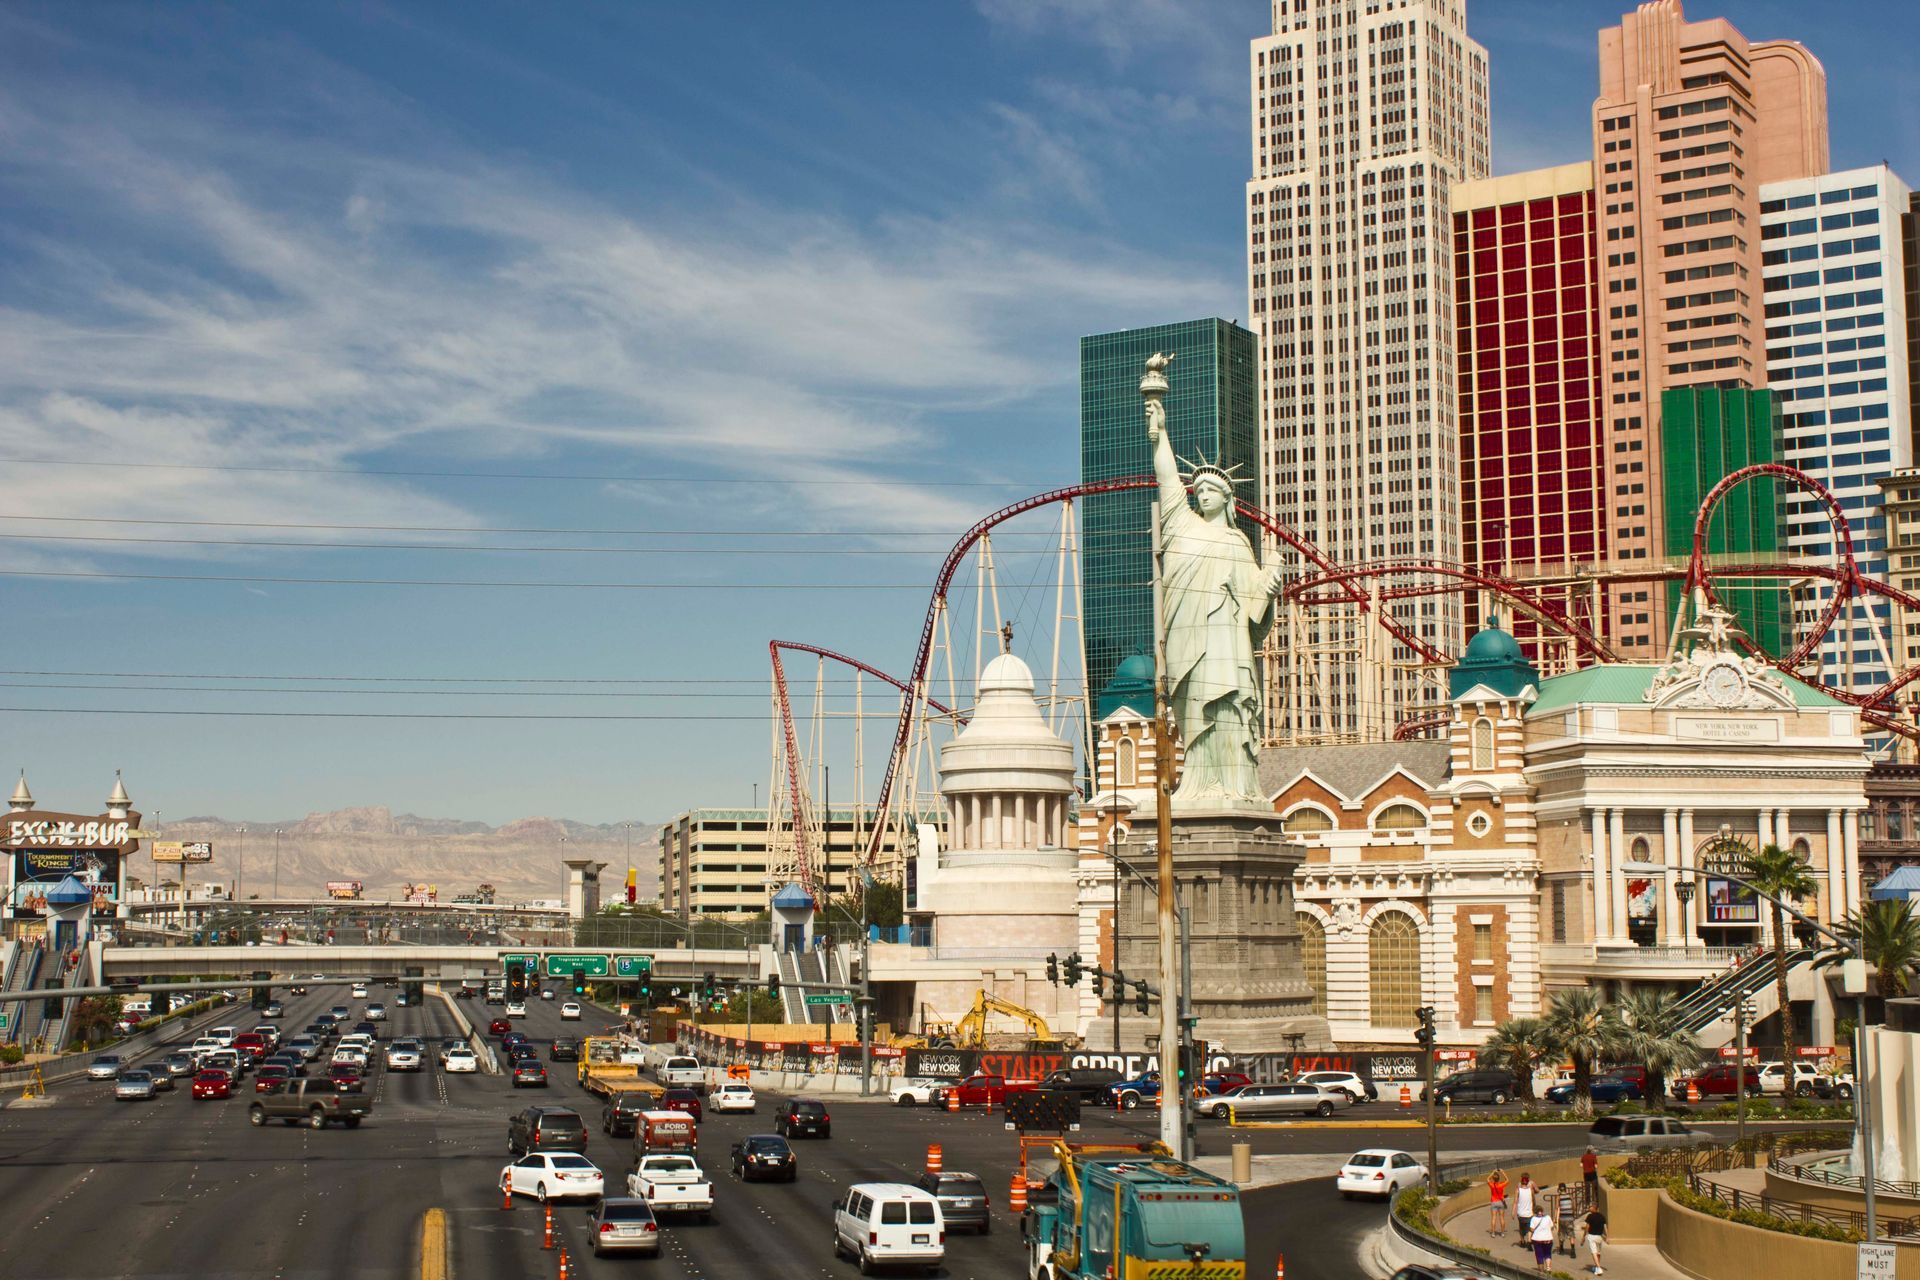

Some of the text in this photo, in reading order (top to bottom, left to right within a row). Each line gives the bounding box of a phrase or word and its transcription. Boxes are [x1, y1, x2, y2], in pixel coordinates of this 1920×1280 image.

[8, 821, 129, 846] EXCALIBUR
[525, 958, 535, 968] 15
[620, 961, 631, 970] 15
[1723, 1048, 1738, 1056] COMIN
[919, 1054, 961, 1064] NEW YORK
[1371, 1056, 1416, 1066] NEW YORK
[919, 1063, 961, 1073] NEW YORK
[981, 1055, 1063, 1081] START
[1371, 1065, 1417, 1075] NEW YORK
[1867, 1260, 1889, 1269] MUST
